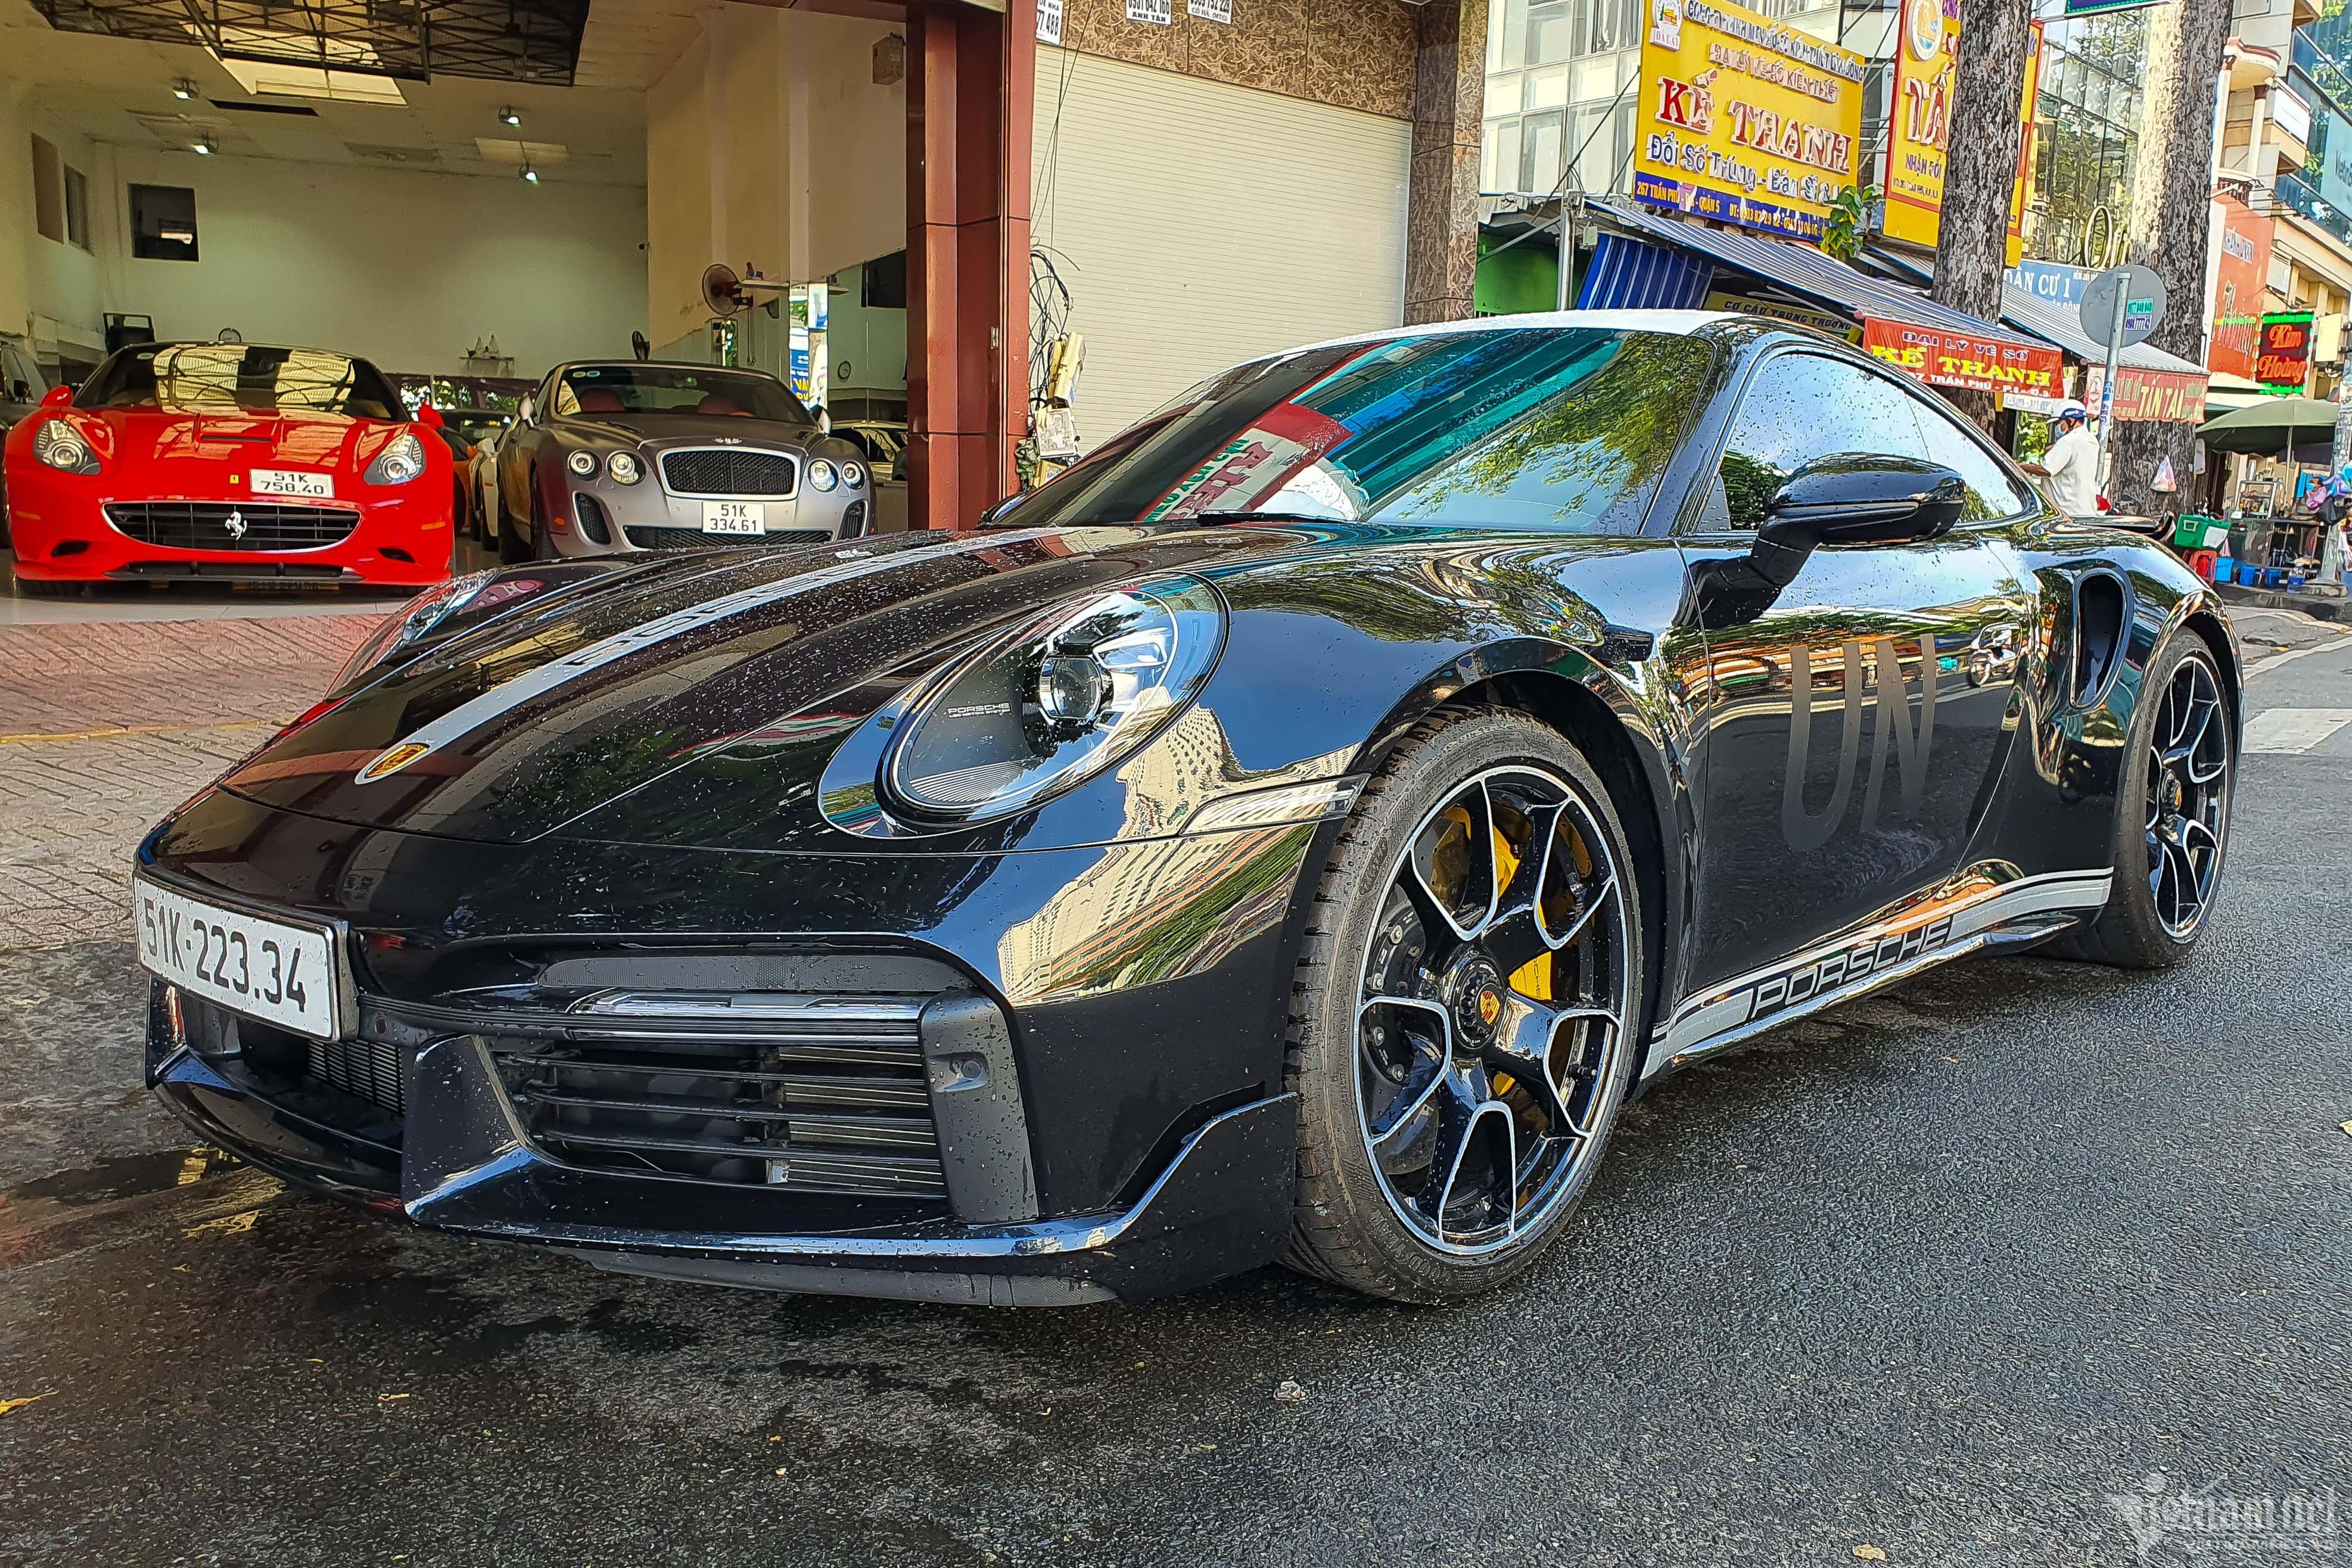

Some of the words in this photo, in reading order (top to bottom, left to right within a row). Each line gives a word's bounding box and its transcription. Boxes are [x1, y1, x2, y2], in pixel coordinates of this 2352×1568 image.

[1037, 9, 1059, 36] 77.488
[1132, 11, 1149, 20] ANH
[1905, 58, 1949, 153] TẤ
[1656, 70, 1718, 135] KẾ
[1728, 100, 1852, 174] THANH
[1647, 130, 1679, 167] Đổi
[1681, 144, 1709, 173] Số
[1708, 150, 1757, 194] Trúng
[1767, 166, 1799, 198] Bán
[1637, 181, 1649, 197] 267
[2038, 273, 2061, 297] CƯ
[2063, 278, 2071, 298] 1
[1724, 300, 1743, 310] CƠ
[2269, 324, 2303, 349] Kim
[1871, 344, 1927, 369] KẾ
[1939, 356, 2052, 387] THANH
[2258, 354, 2307, 384] Hoàng
[2138, 374, 2164, 418] TẤN
[2162, 379, 2185, 419] TÀI
[274, 472, 309, 484] 51K
[720, 504, 747, 518] 51K
[710, 518, 757, 532] 334.61
[948, 702, 1010, 714] PORSCHE
[144, 897, 306, 1013] 51K-223.34
[1750, 914, 1954, 1018] PORSCHE
